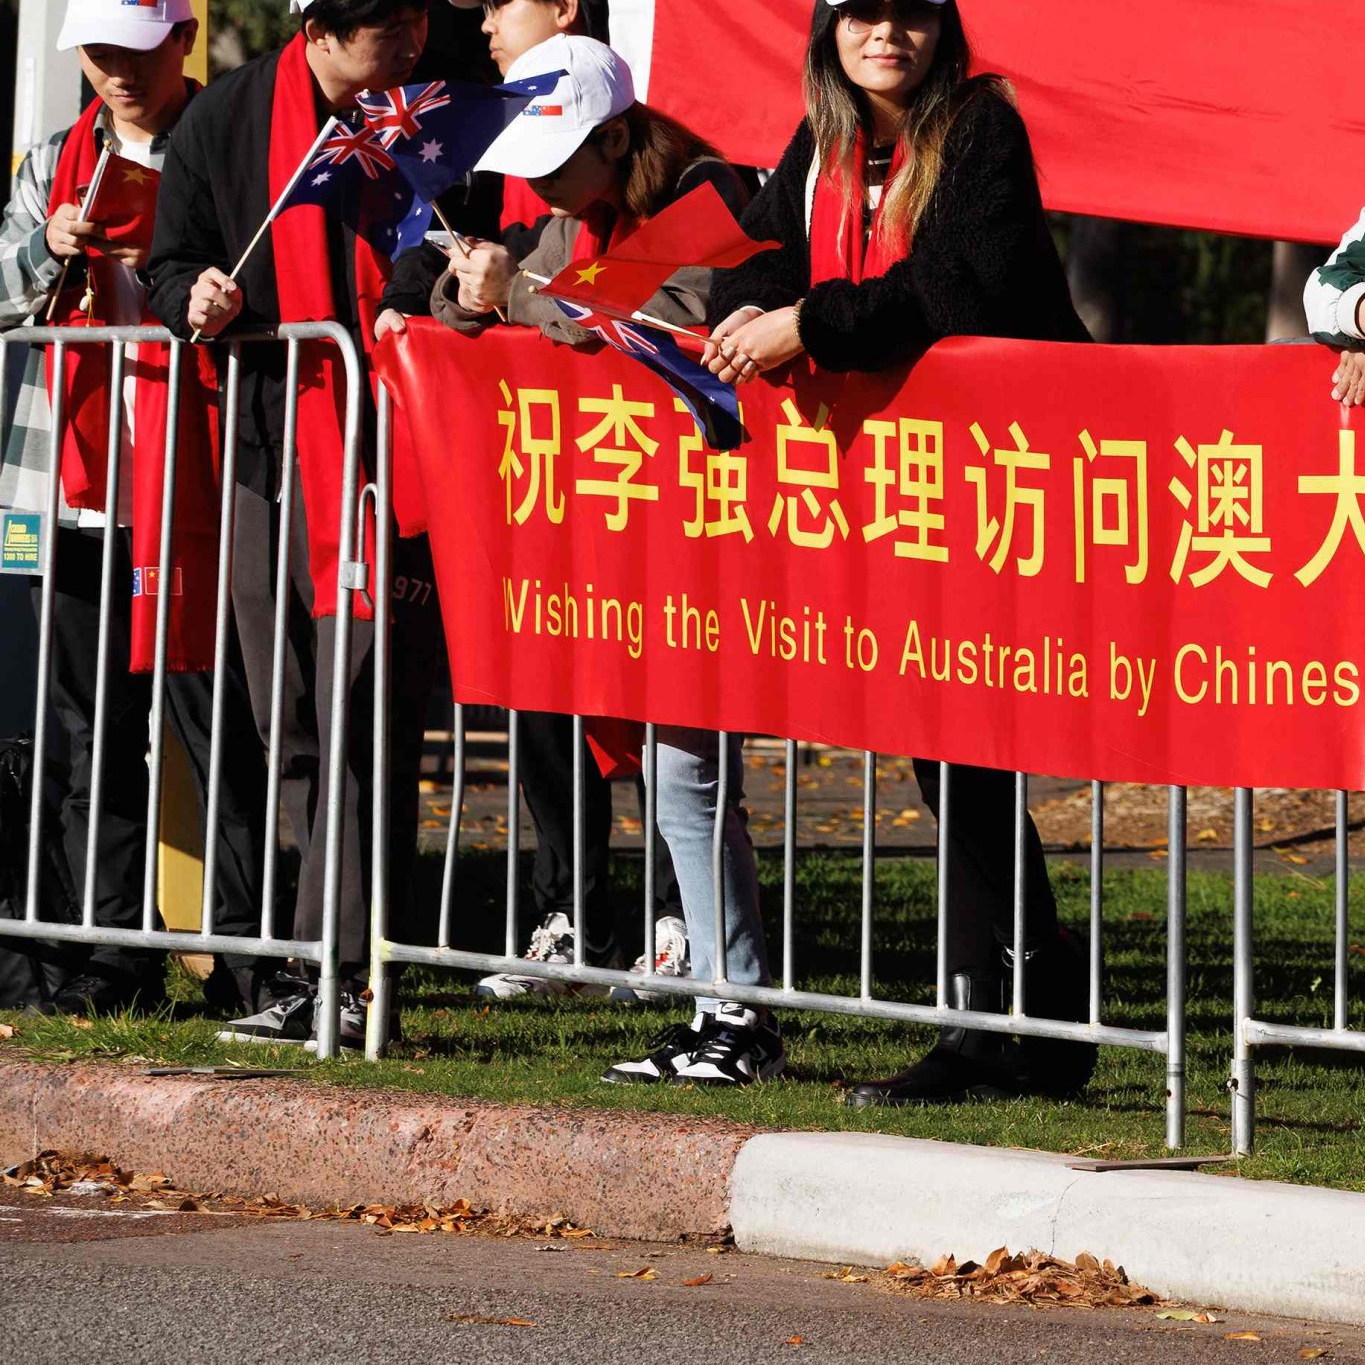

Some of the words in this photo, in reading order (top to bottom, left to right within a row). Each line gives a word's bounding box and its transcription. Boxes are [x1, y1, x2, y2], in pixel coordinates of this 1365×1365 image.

[502, 577, 643, 659] Wishing
[663, 594, 720, 652] the
[740, 597, 827, 666] Visit
[844, 615, 879, 672] to
[899, 619, 1090, 699] Australia
[1110, 641, 1156, 717] by
